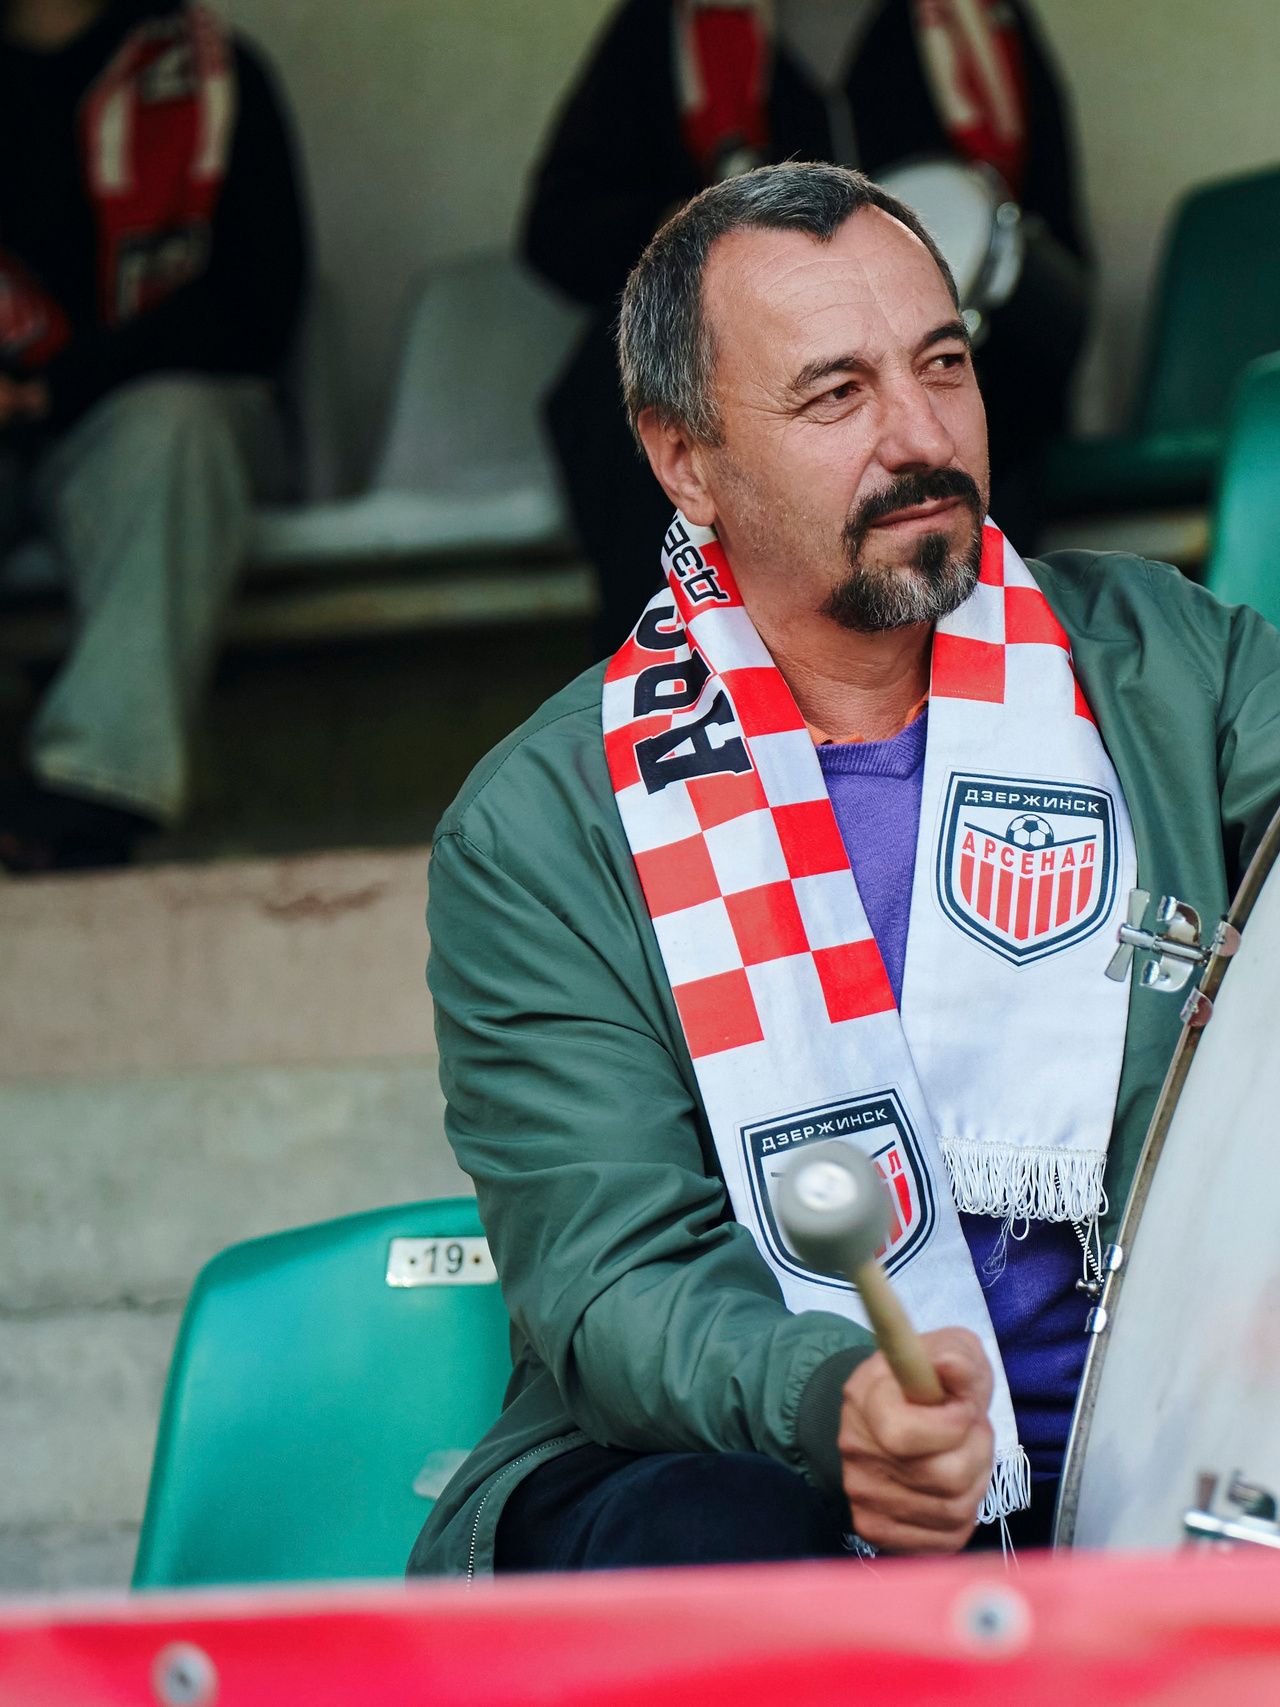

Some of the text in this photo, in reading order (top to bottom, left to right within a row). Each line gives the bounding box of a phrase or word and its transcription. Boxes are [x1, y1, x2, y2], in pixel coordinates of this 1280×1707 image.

[663, 515, 729, 604] ДЗЕ
[964, 788, 1100, 814] ДЗЕРЖИНСК
[961, 830, 1096, 876] АРСЕНАЛ
[761, 1107, 888, 1153] ДЗЕРЖИНСК
[423, 1243, 464, 1274] 19
